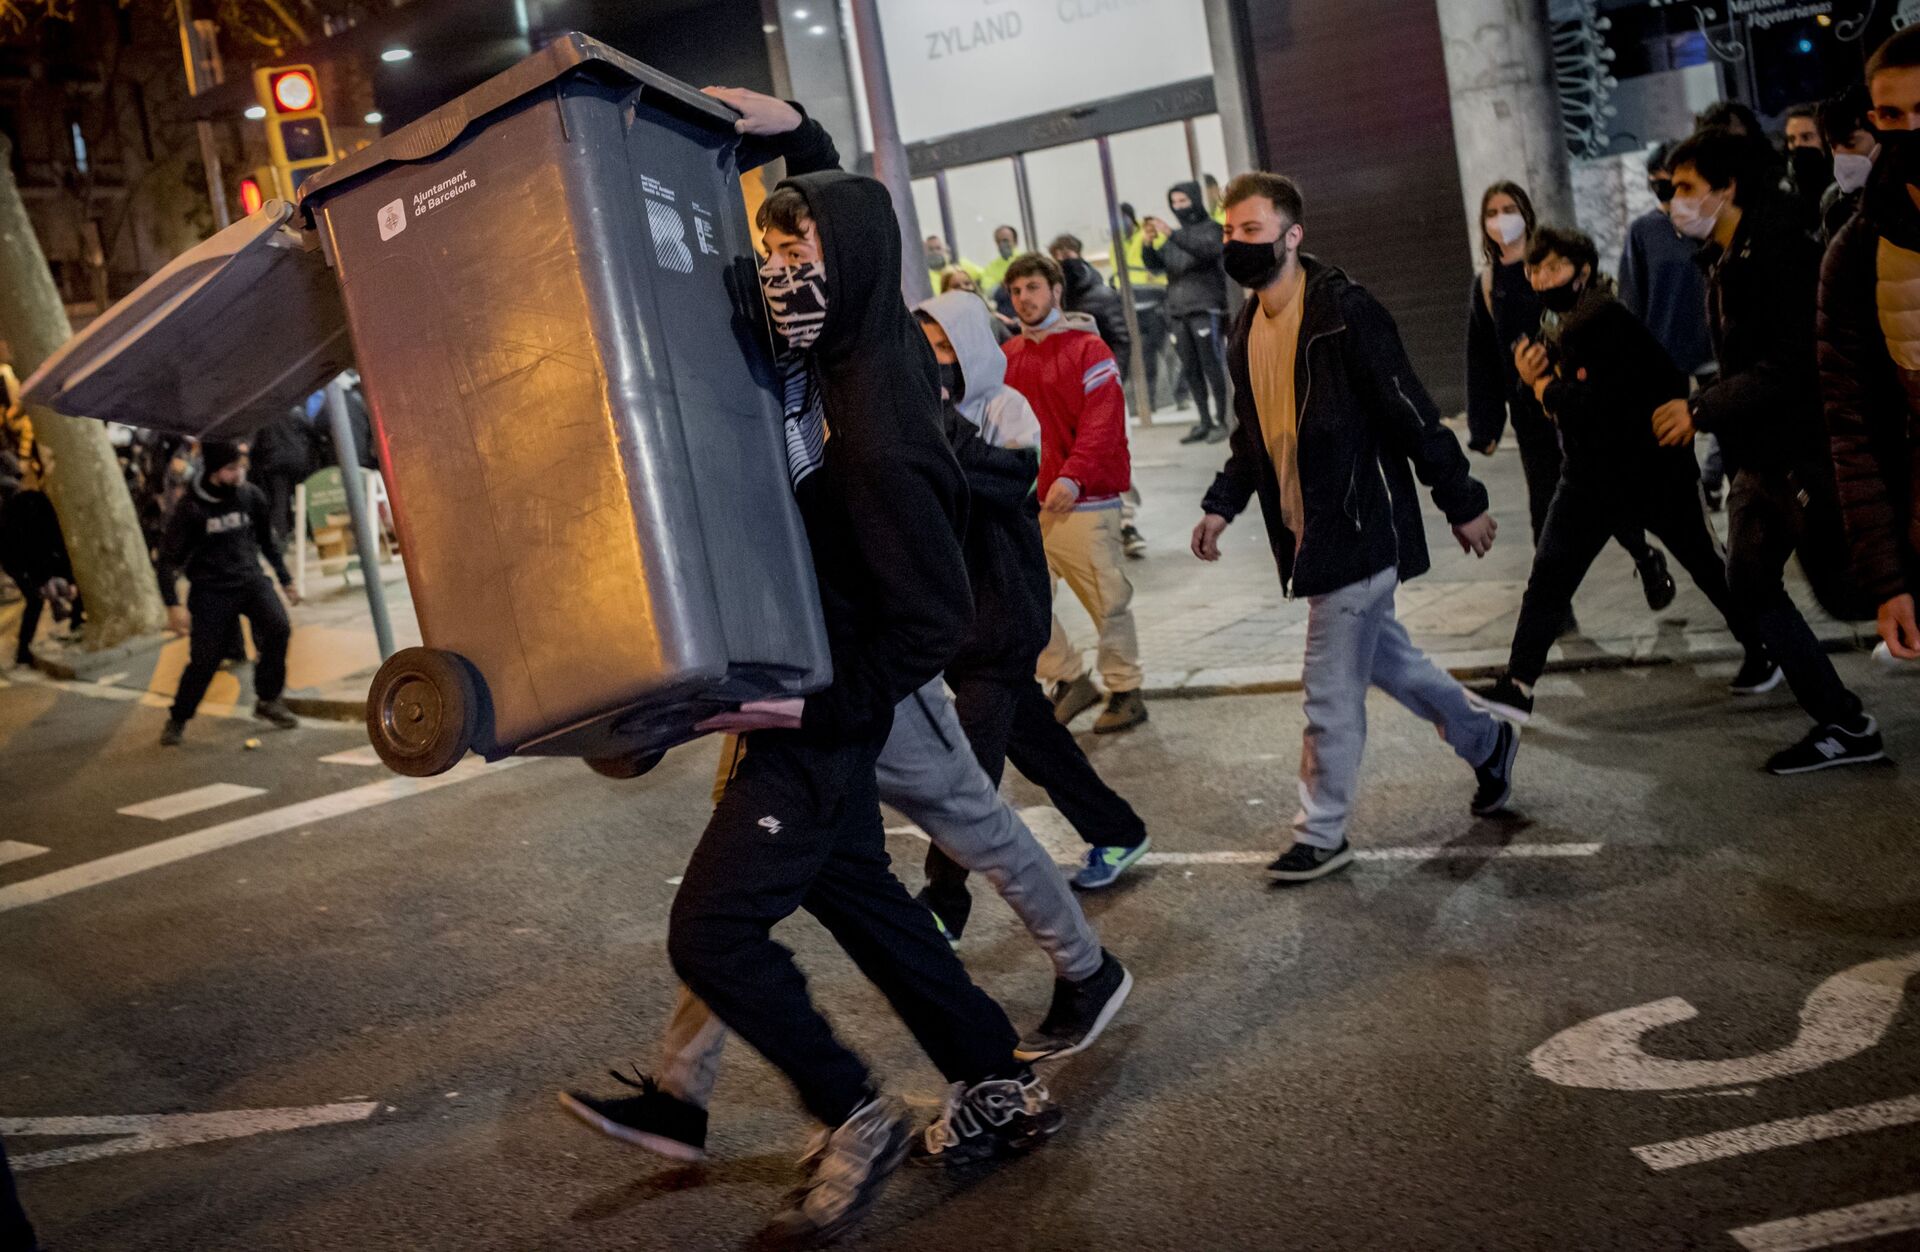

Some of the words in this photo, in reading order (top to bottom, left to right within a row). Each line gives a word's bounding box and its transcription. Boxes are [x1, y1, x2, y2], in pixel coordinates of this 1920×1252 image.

[924, 10, 1023, 60] ZYLAND
[413, 169, 468, 206] Ajuntament
[414, 205, 427, 217] de
[428, 178, 478, 210] Barcelona
